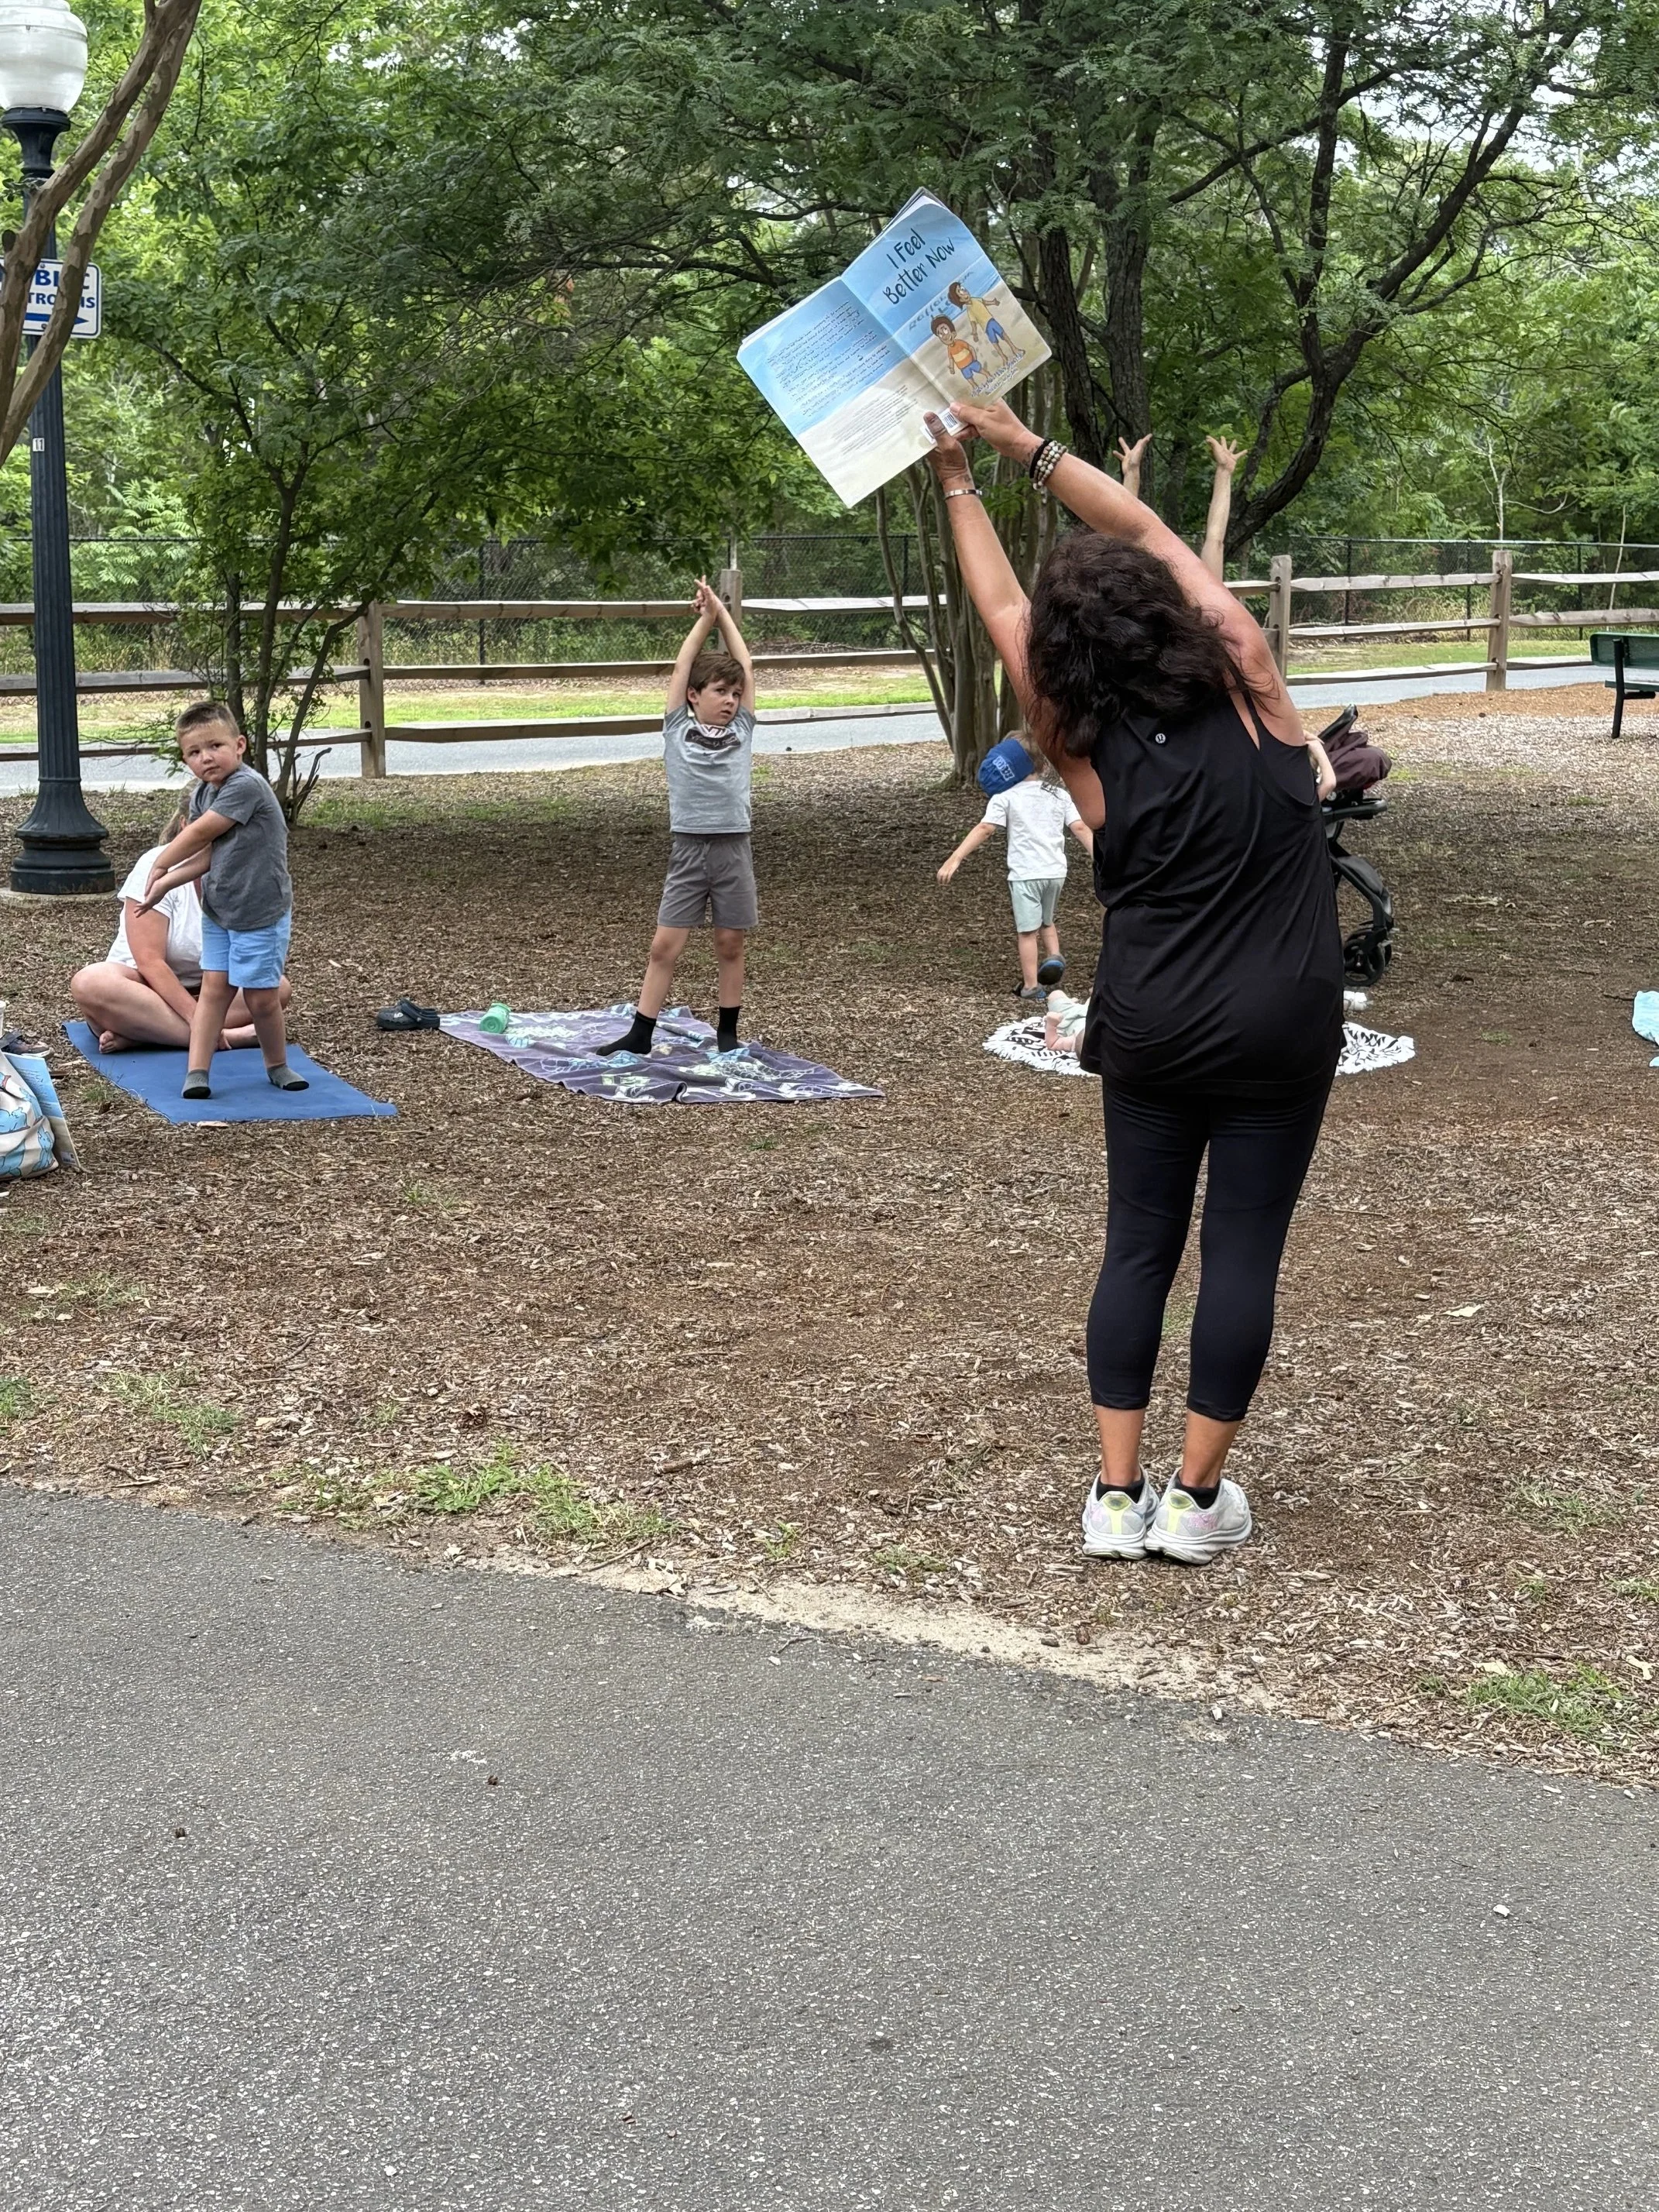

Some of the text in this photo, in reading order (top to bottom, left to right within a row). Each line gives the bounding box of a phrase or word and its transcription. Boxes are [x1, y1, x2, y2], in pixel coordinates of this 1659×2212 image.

[882, 264, 929, 305] Better
[926, 236, 956, 270] Now
[886, 228, 926, 270] I Feel
